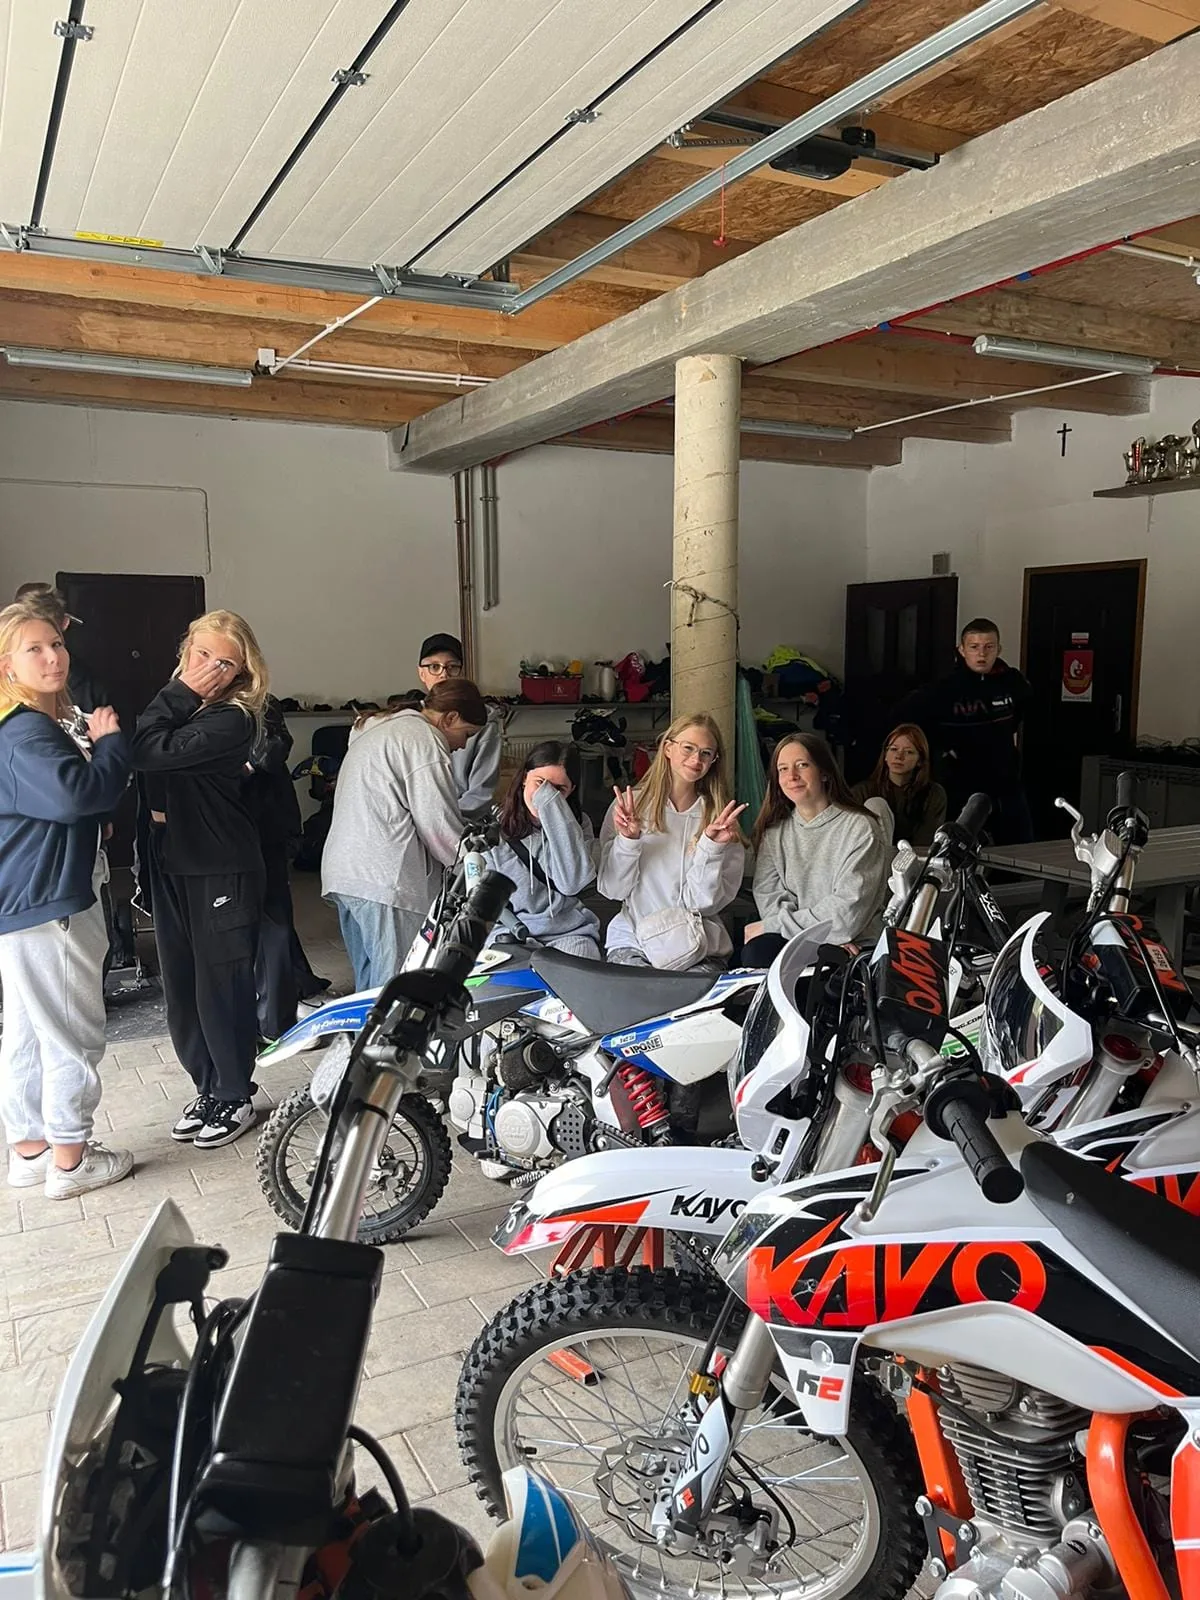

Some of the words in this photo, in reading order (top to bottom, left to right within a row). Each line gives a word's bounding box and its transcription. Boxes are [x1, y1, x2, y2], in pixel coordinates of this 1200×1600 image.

[629, 1036, 662, 1054] IPONE
[746, 1211, 1047, 1327] KAYO
[796, 1369, 844, 1401] K2
